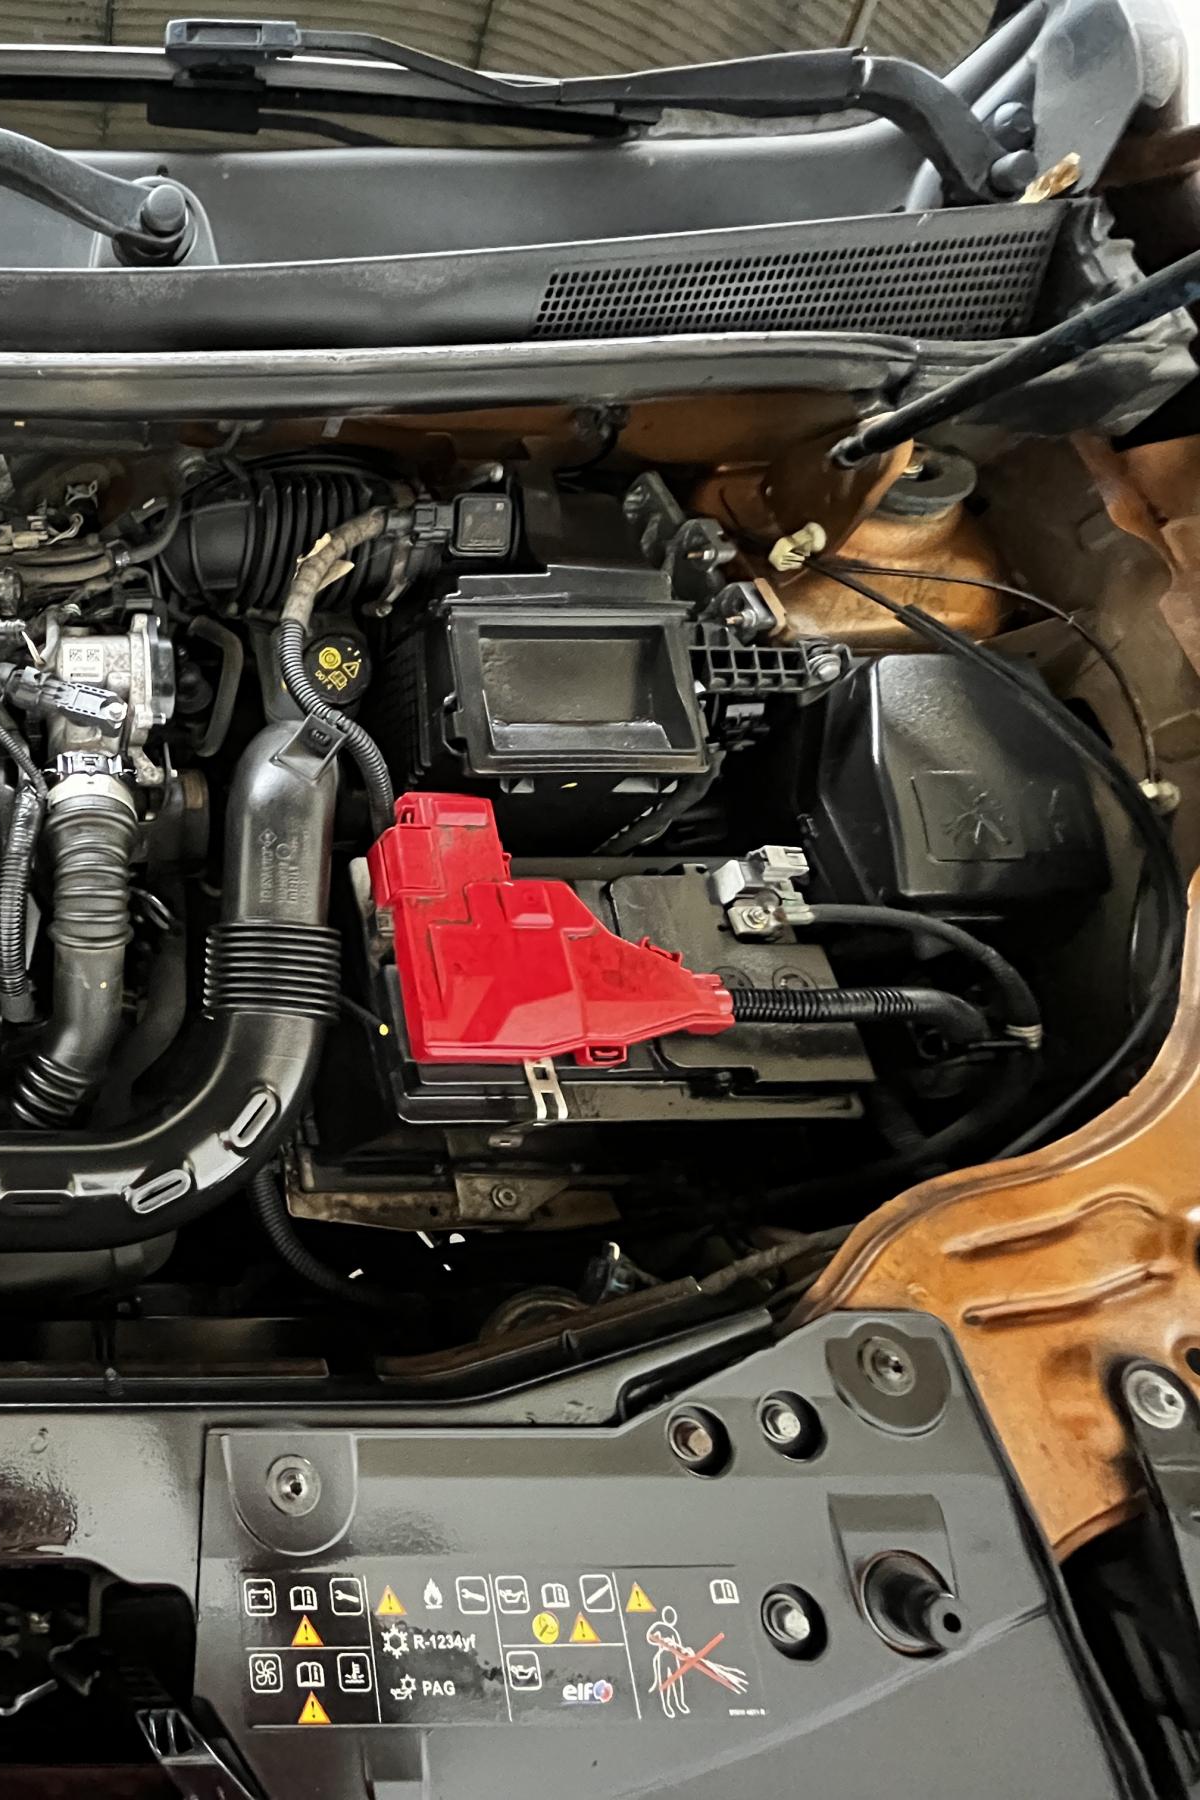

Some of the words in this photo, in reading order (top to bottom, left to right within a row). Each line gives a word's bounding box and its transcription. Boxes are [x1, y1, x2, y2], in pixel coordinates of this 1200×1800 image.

[413, 1633, 477, 1653] R-1234yf
[422, 1680, 456, 1697] PAG
[562, 1681, 595, 1702] elf
